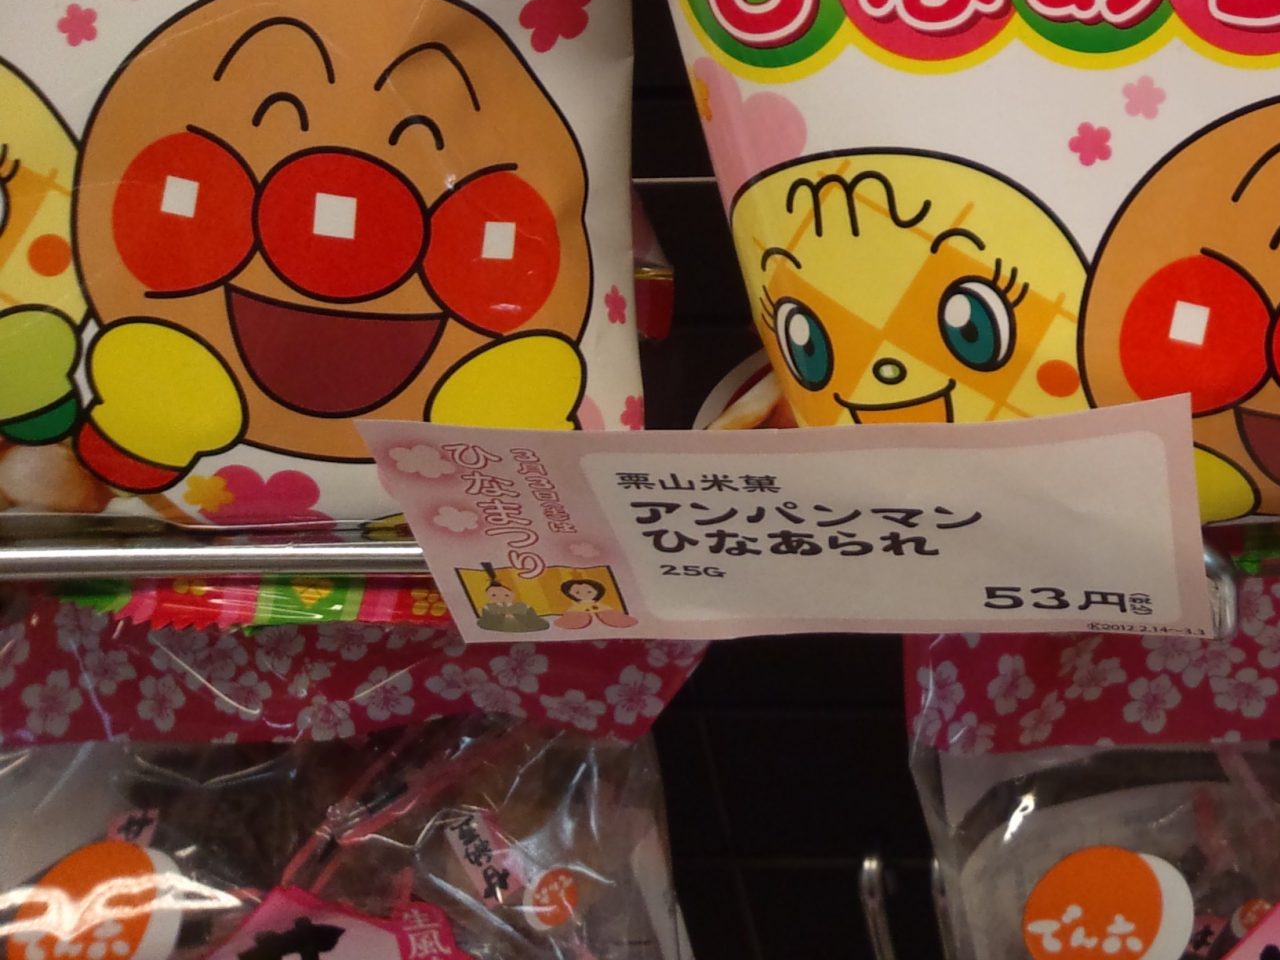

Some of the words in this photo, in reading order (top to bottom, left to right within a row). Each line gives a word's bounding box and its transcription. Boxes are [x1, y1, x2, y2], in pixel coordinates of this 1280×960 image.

[616, 472, 781, 493] 栗山米菓
[441, 443, 546, 579] ひなまつり
[630, 501, 982, 529] アンパンマン
[642, 529, 940, 556] ひなあられ
[659, 565, 727, 578] 25G
[1027, 904, 1144, 954] でん六
